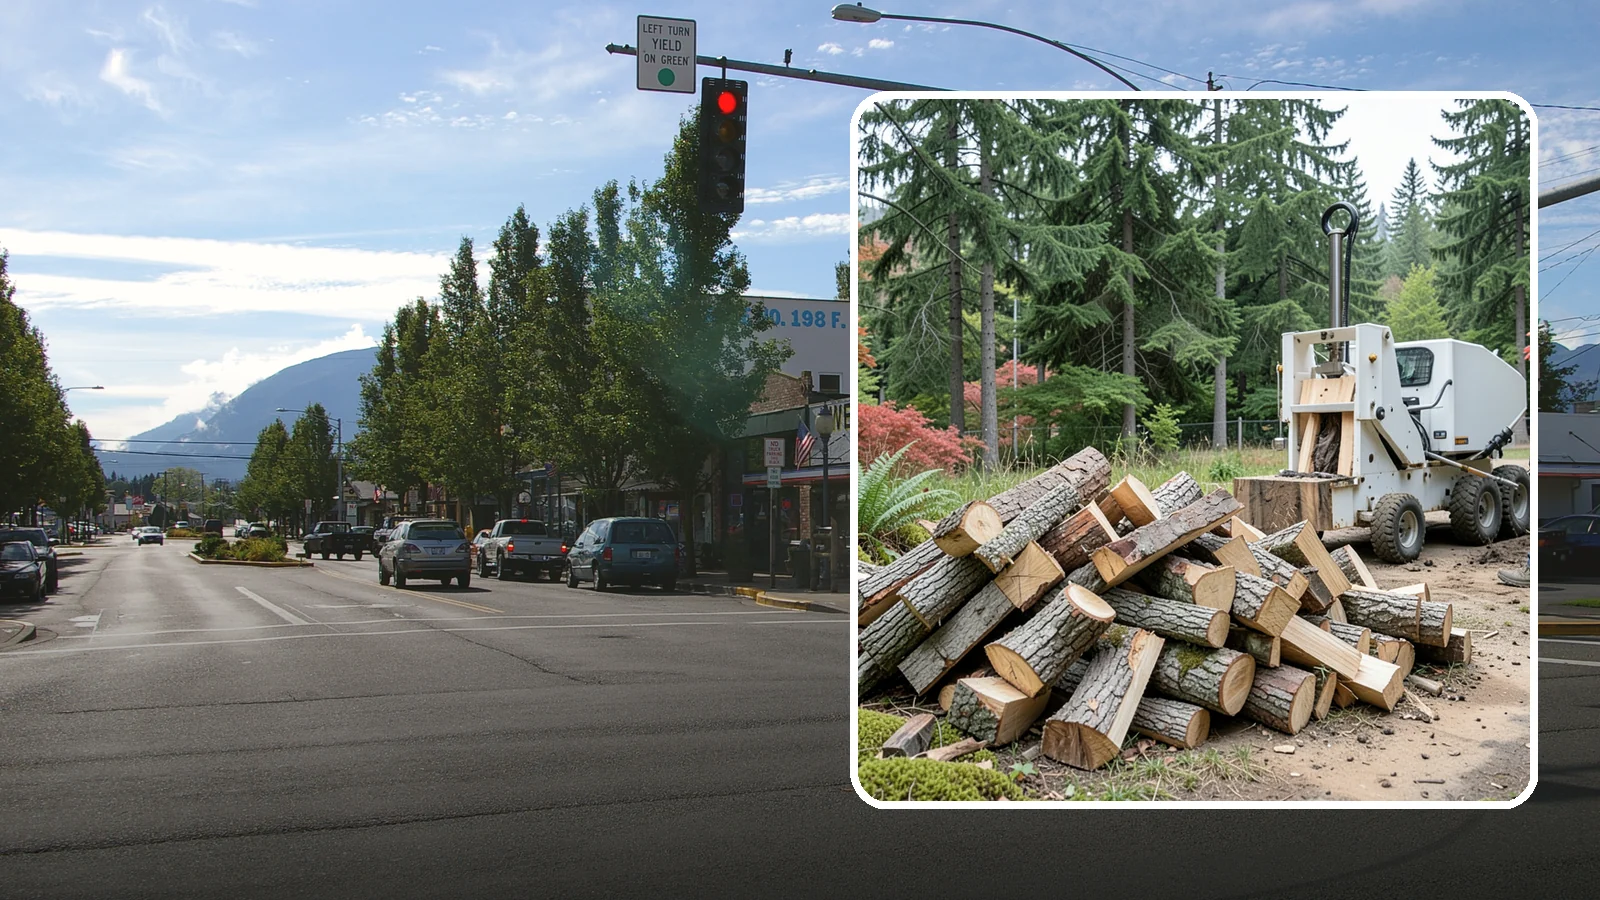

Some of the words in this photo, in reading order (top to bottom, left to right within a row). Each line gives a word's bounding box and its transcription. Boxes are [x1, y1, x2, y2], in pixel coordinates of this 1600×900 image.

[643, 23, 663, 34] LEFT
[668, 25, 690, 36] TURN
[652, 38, 682, 52] YIELD
[644, 53, 656, 63] ON
[661, 54, 689, 66] GREEN
[791, 309, 826, 328] 198
[831, 311, 846, 329] F.
